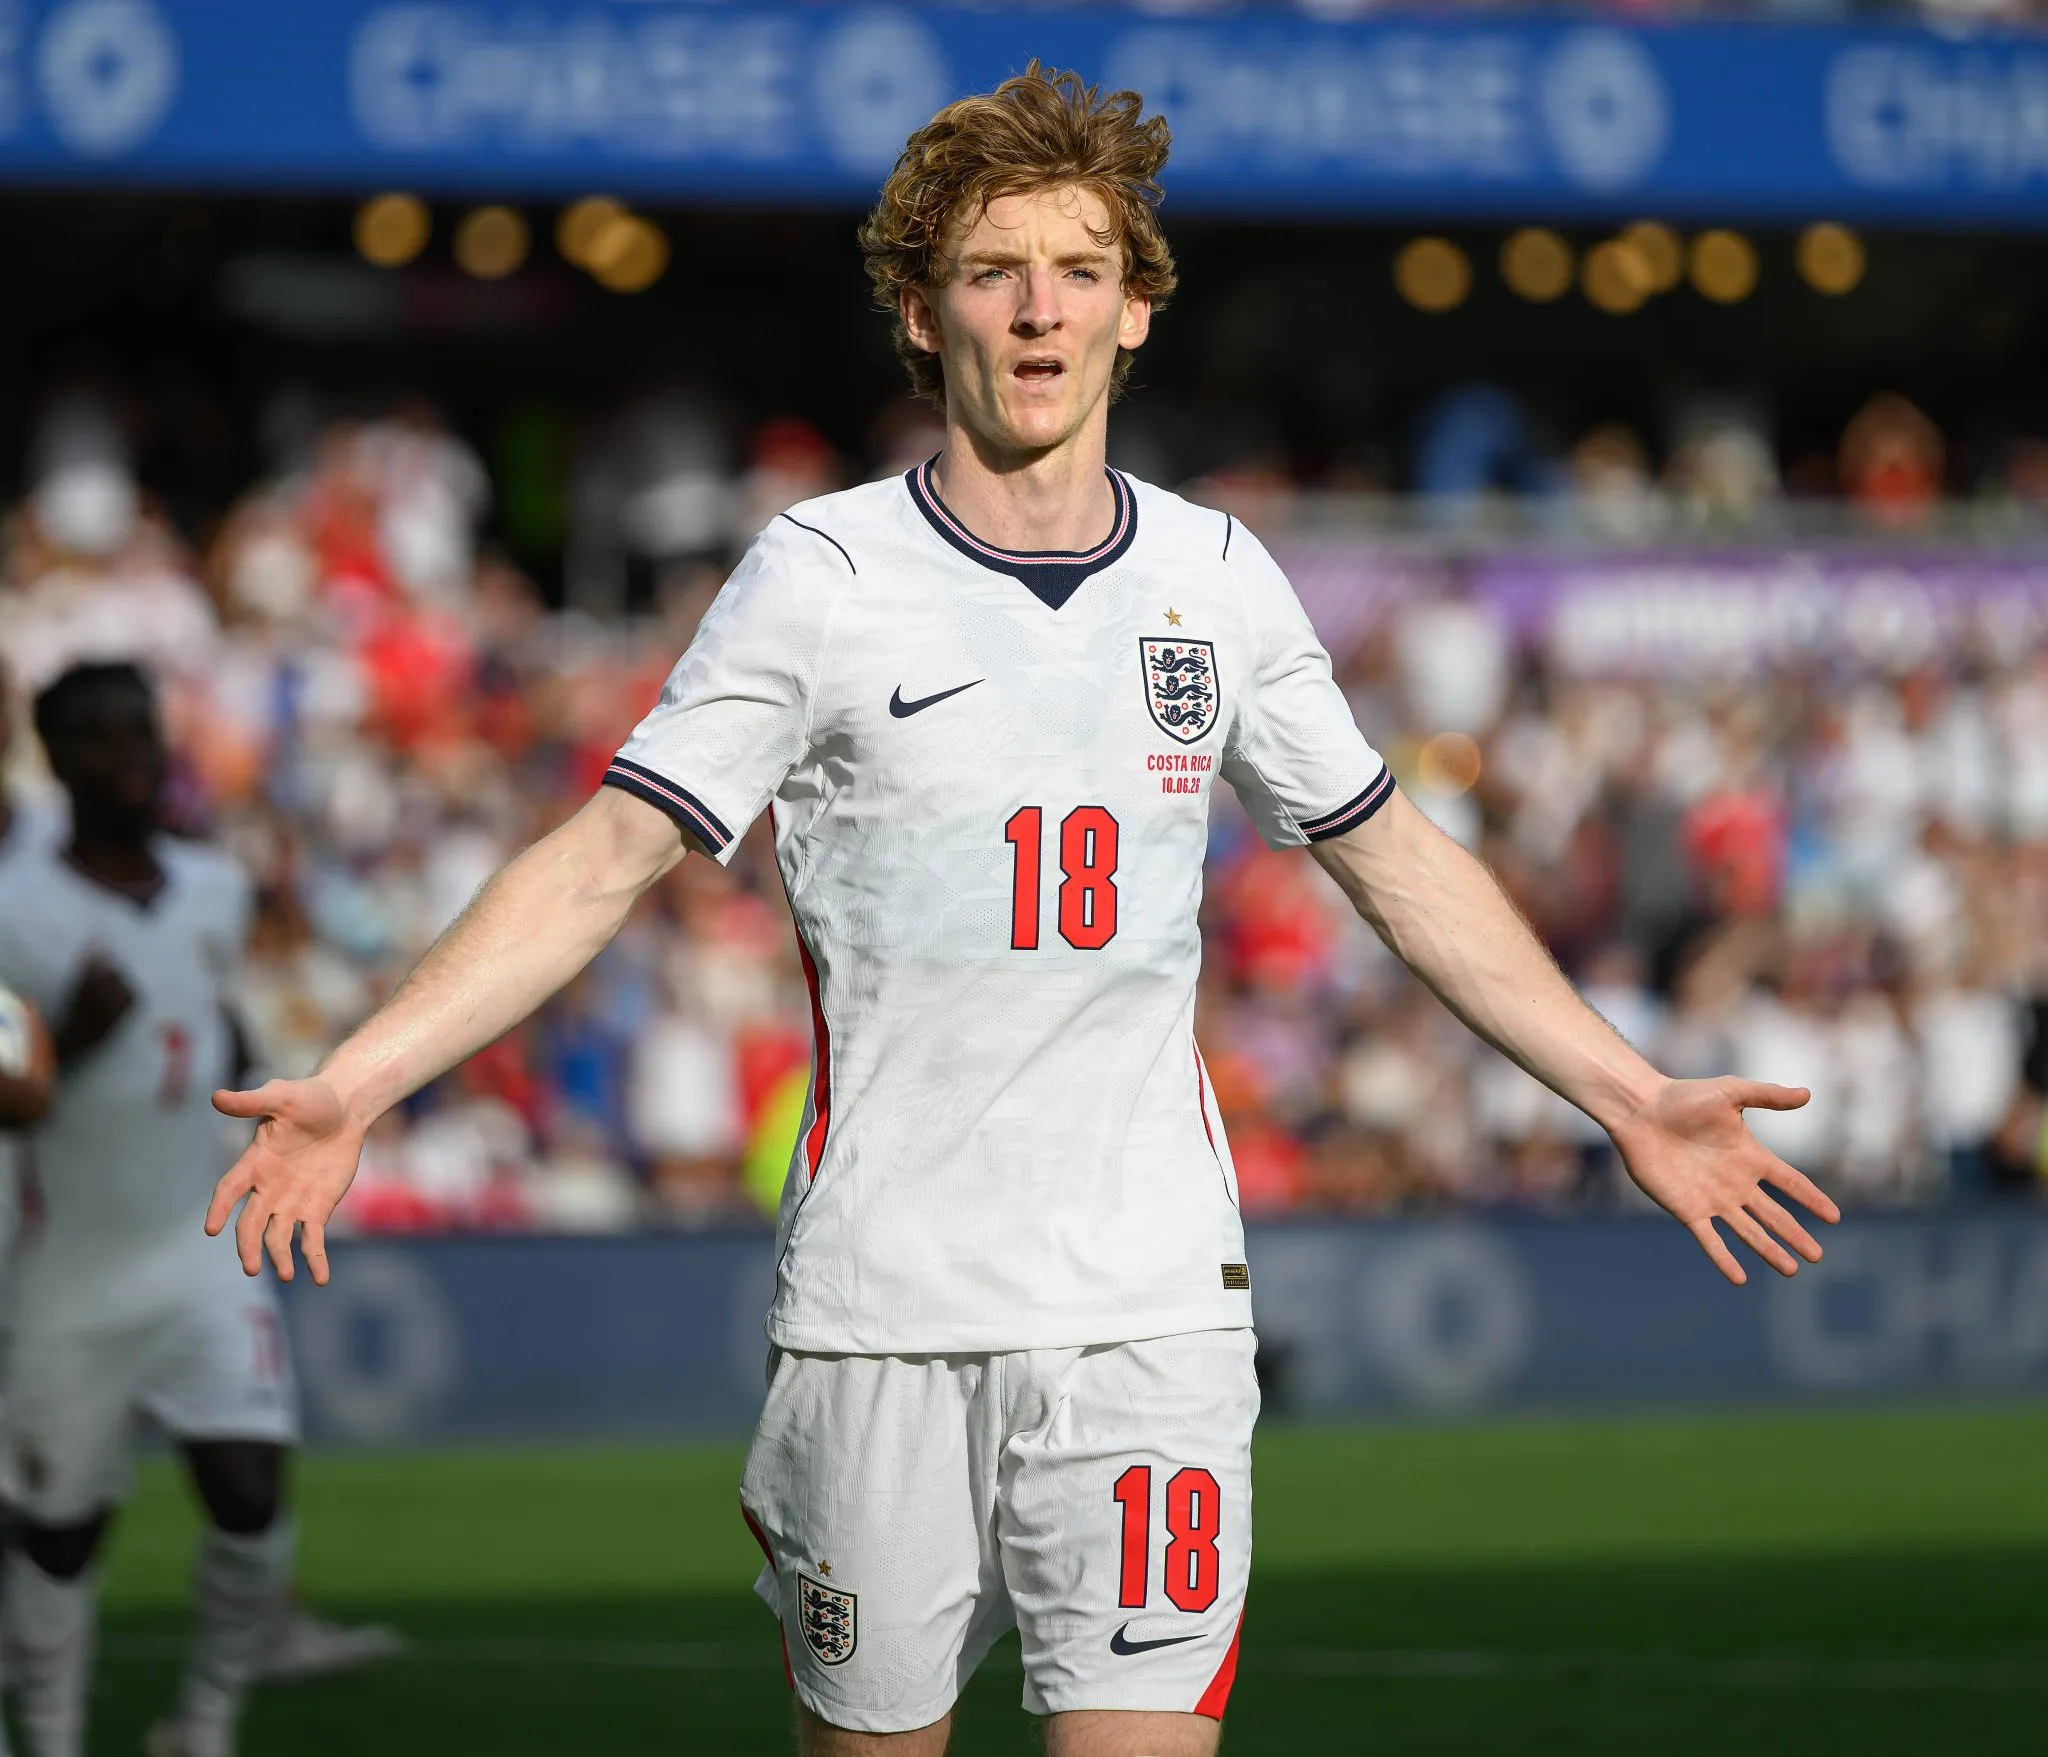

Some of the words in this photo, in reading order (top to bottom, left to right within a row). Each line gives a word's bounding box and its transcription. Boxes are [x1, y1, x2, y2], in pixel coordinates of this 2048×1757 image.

[1147, 755, 1188, 772] COSTA
[1190, 755, 1212, 772] RICA
[1162, 777, 1201, 794] 10.06.26
[1005, 806, 1120, 950] 18
[1113, 1465, 1221, 1613] 18
